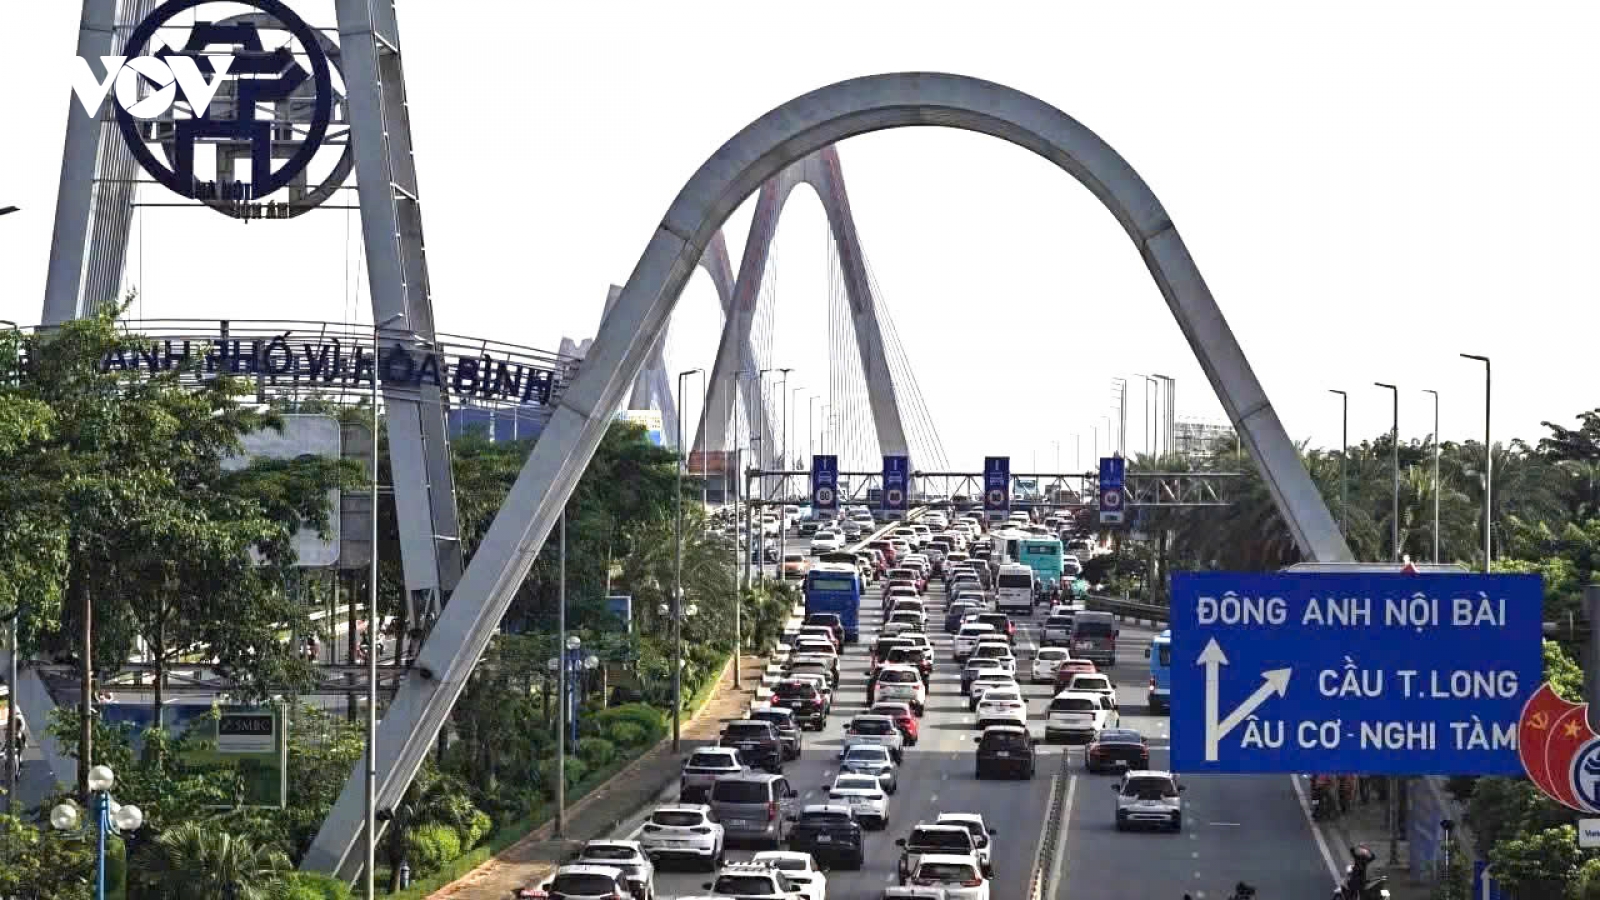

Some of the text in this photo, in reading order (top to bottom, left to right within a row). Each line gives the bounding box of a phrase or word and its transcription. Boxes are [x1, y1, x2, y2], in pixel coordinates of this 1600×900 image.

[1197, 591, 1506, 633] ĐÔNG ANH NỘI BÀI
[1319, 655, 1518, 698] CẦU T.LONG
[1241, 714, 1285, 748] ÂU
[1449, 715, 1518, 750] TÀM
